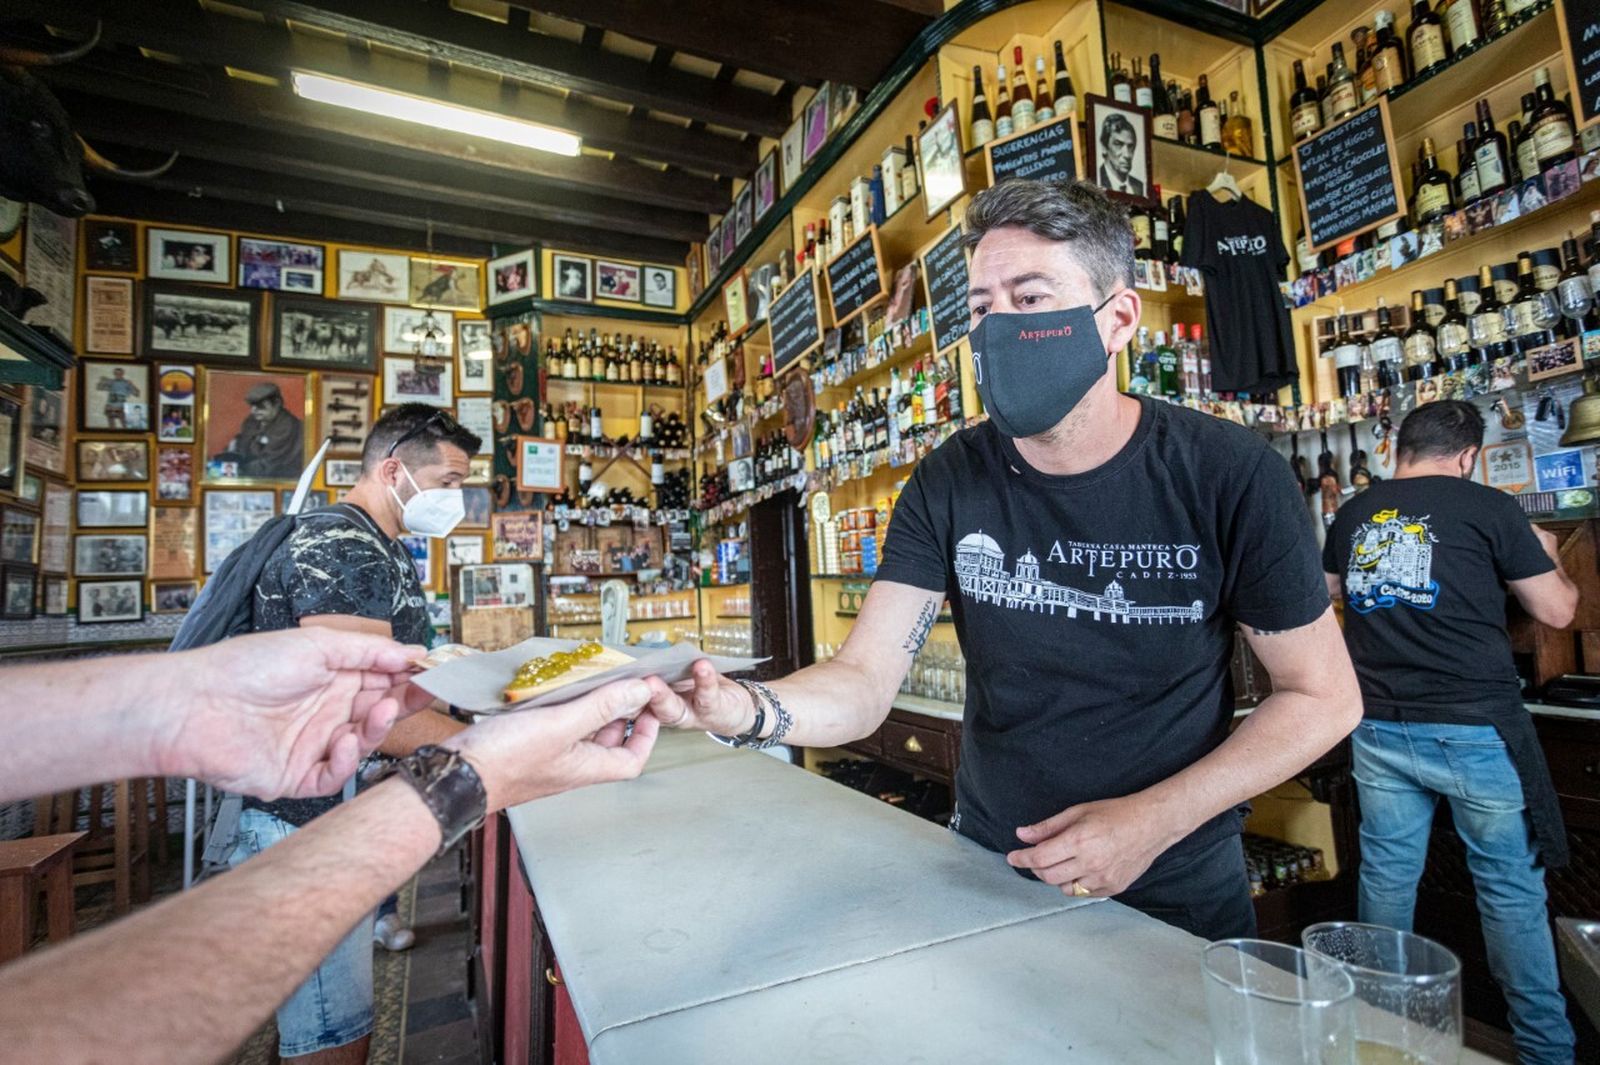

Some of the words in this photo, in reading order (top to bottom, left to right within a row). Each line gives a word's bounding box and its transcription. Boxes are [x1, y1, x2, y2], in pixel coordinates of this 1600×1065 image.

[1493, 461, 1522, 473] 2015
[1102, 543, 1126, 551] CASA
[1128, 543, 1171, 551] MANTECA
